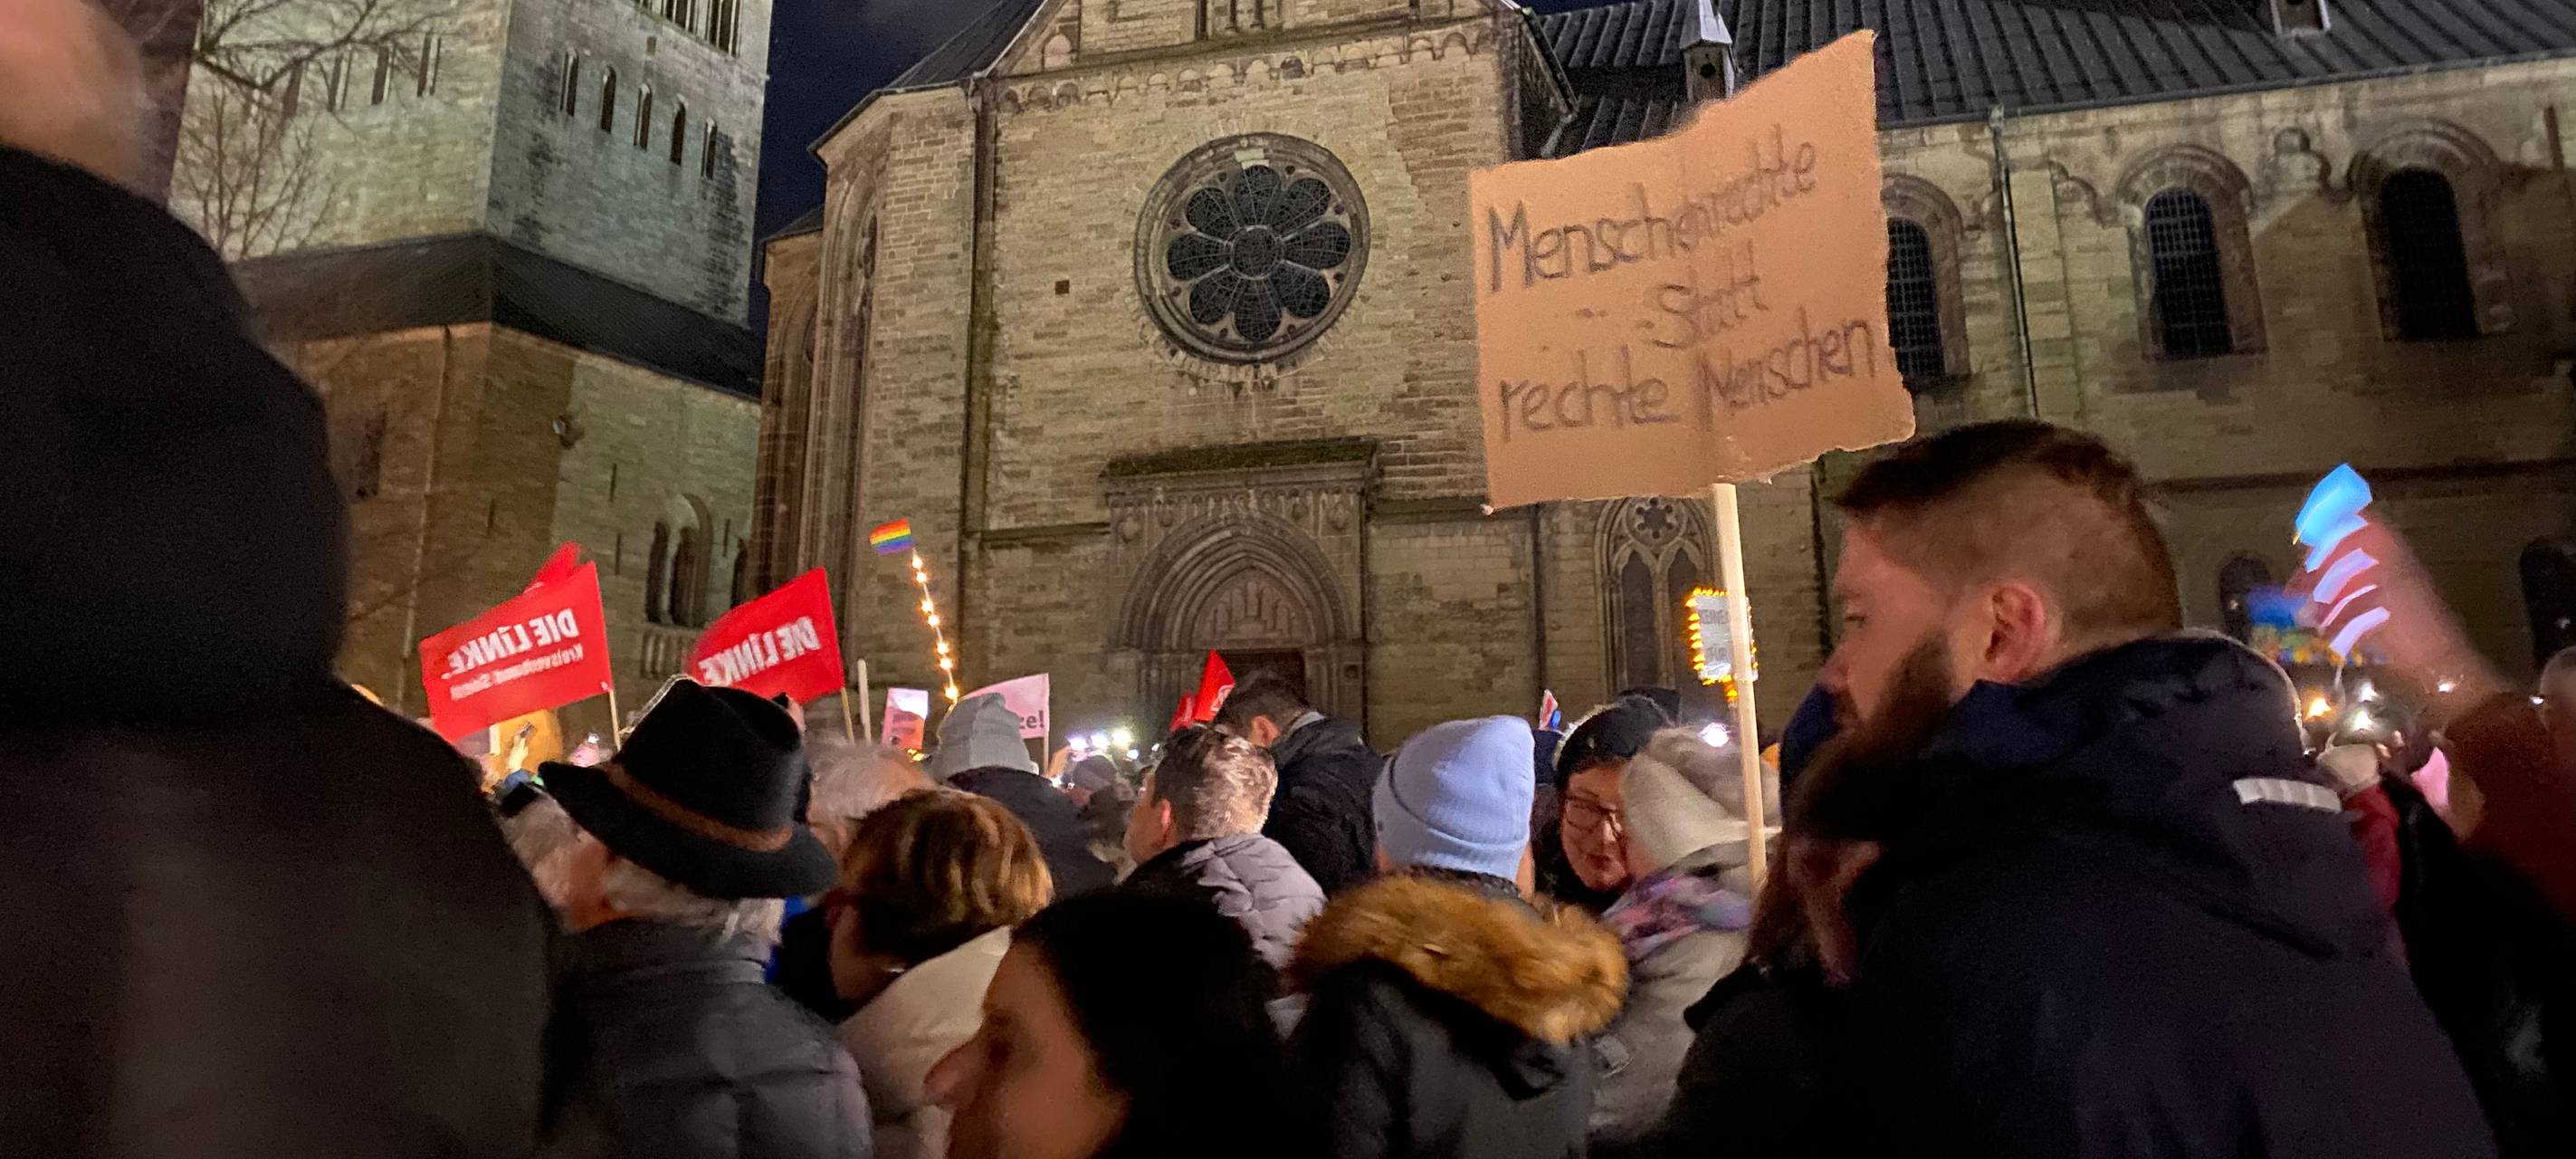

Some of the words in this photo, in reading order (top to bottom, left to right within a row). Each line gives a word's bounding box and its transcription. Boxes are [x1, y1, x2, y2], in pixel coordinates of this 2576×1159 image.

[1487, 124, 1816, 292] Menschenrechte
[1500, 344, 1681, 443] rechte
[1695, 304, 1876, 415] Menschen
